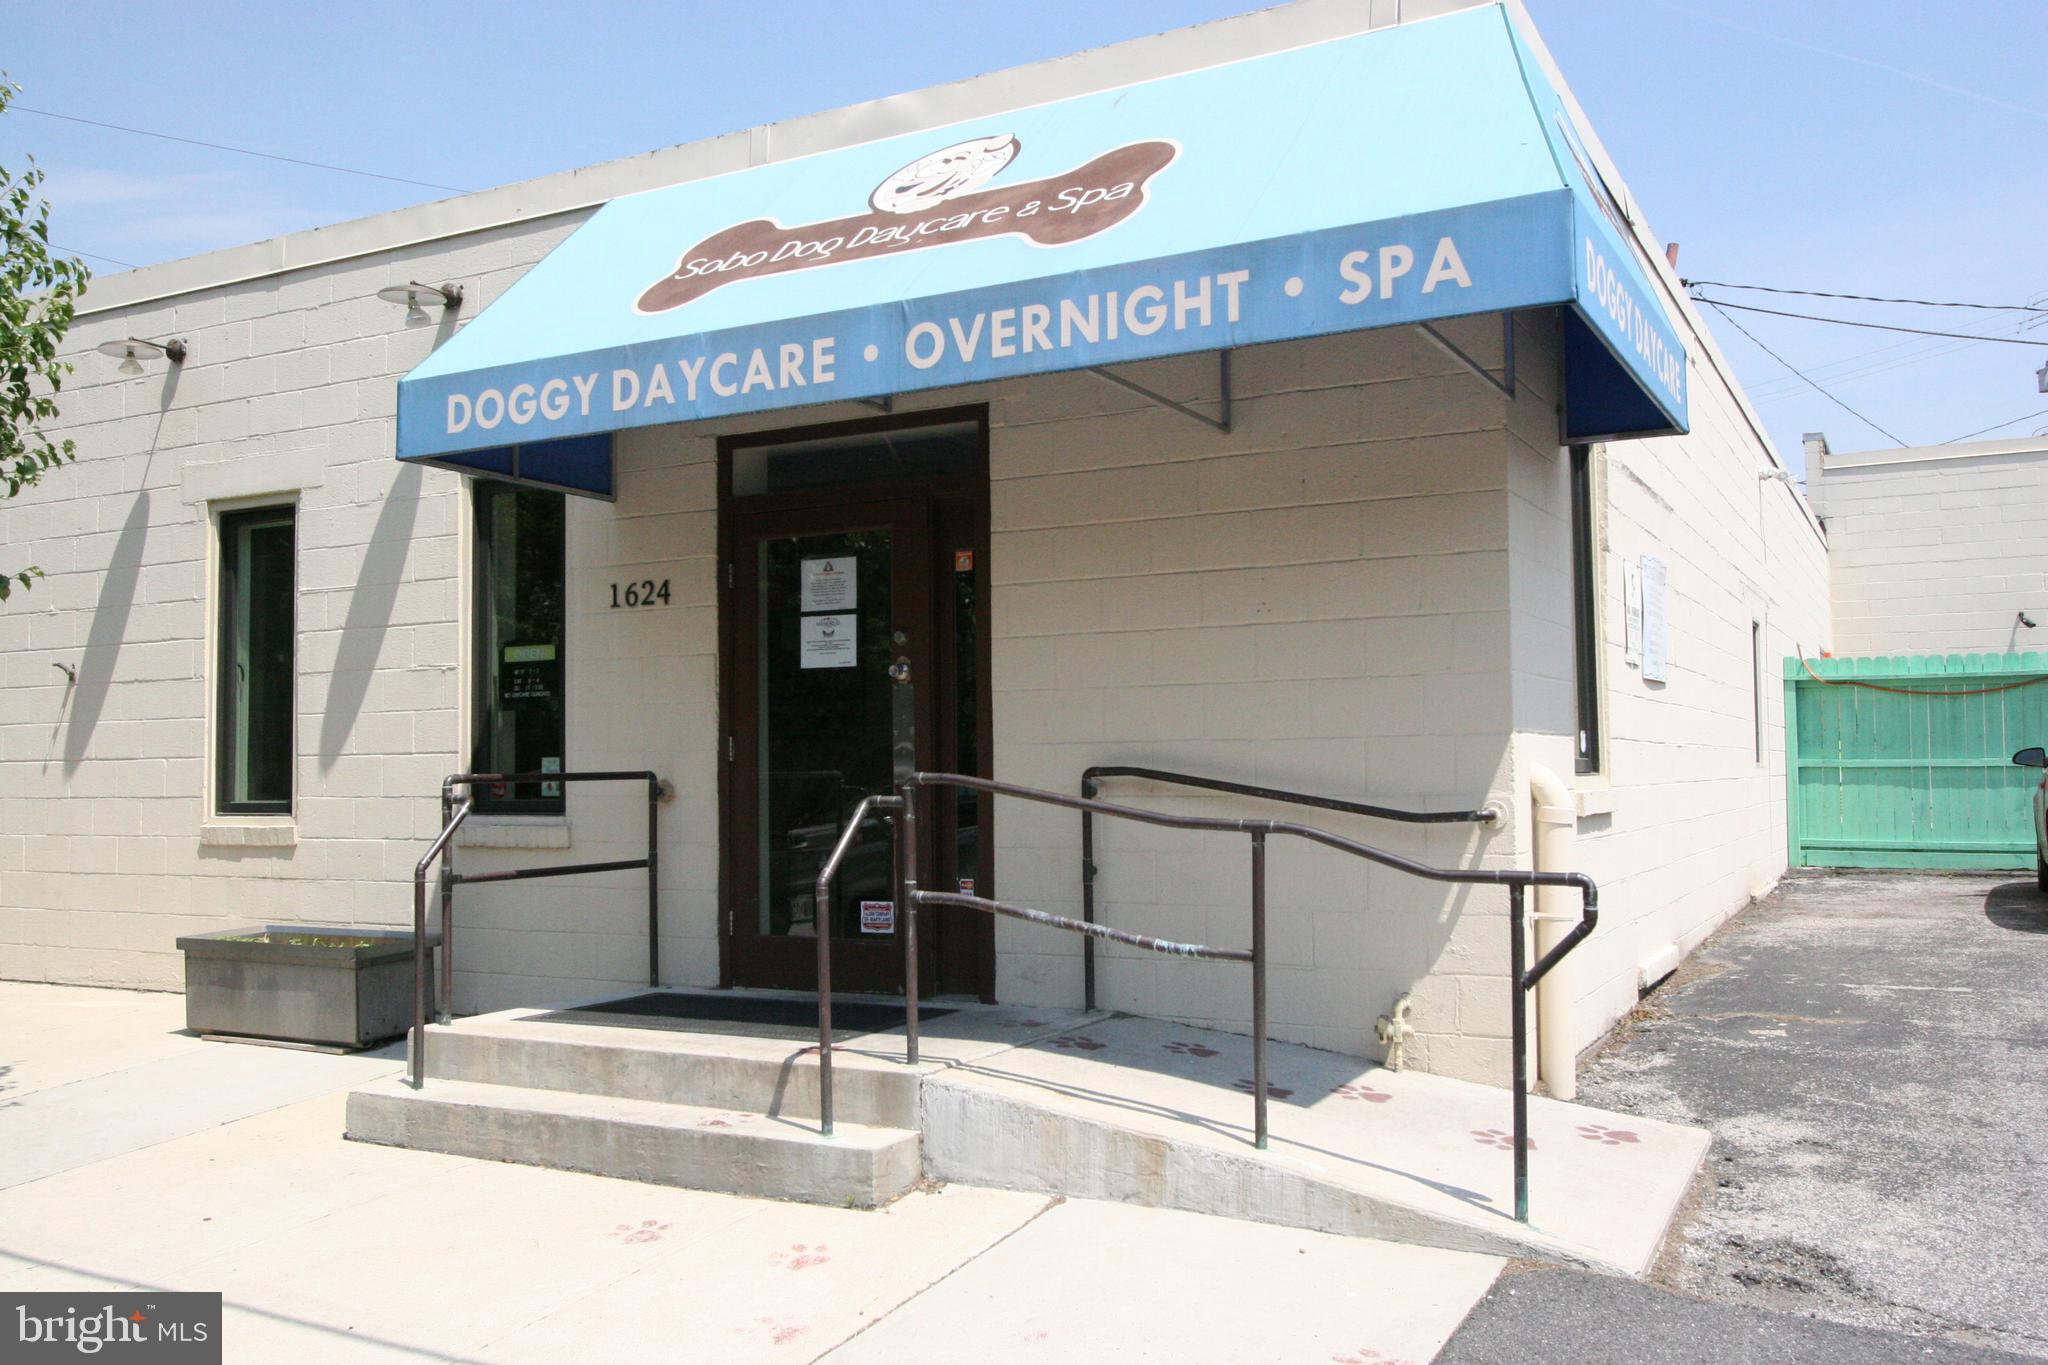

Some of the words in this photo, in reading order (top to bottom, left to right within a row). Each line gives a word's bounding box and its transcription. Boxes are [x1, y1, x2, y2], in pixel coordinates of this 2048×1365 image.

[675, 248, 767, 280] Sobo
[769, 236, 845, 263] Dog
[848, 203, 1009, 247] Daycare
[1016, 200, 1039, 217] &
[1050, 181, 1133, 215] Spa
[1338, 236, 1473, 306] SPA
[904, 269, 1250, 370] OVERNIGHT
[1585, 236, 1632, 342] DOGGY
[1634, 305, 1681, 404] DAYCARE
[446, 372, 599, 435] DOGGY
[612, 337, 836, 412] DAYCARE
[609, 579, 672, 609] 1624
